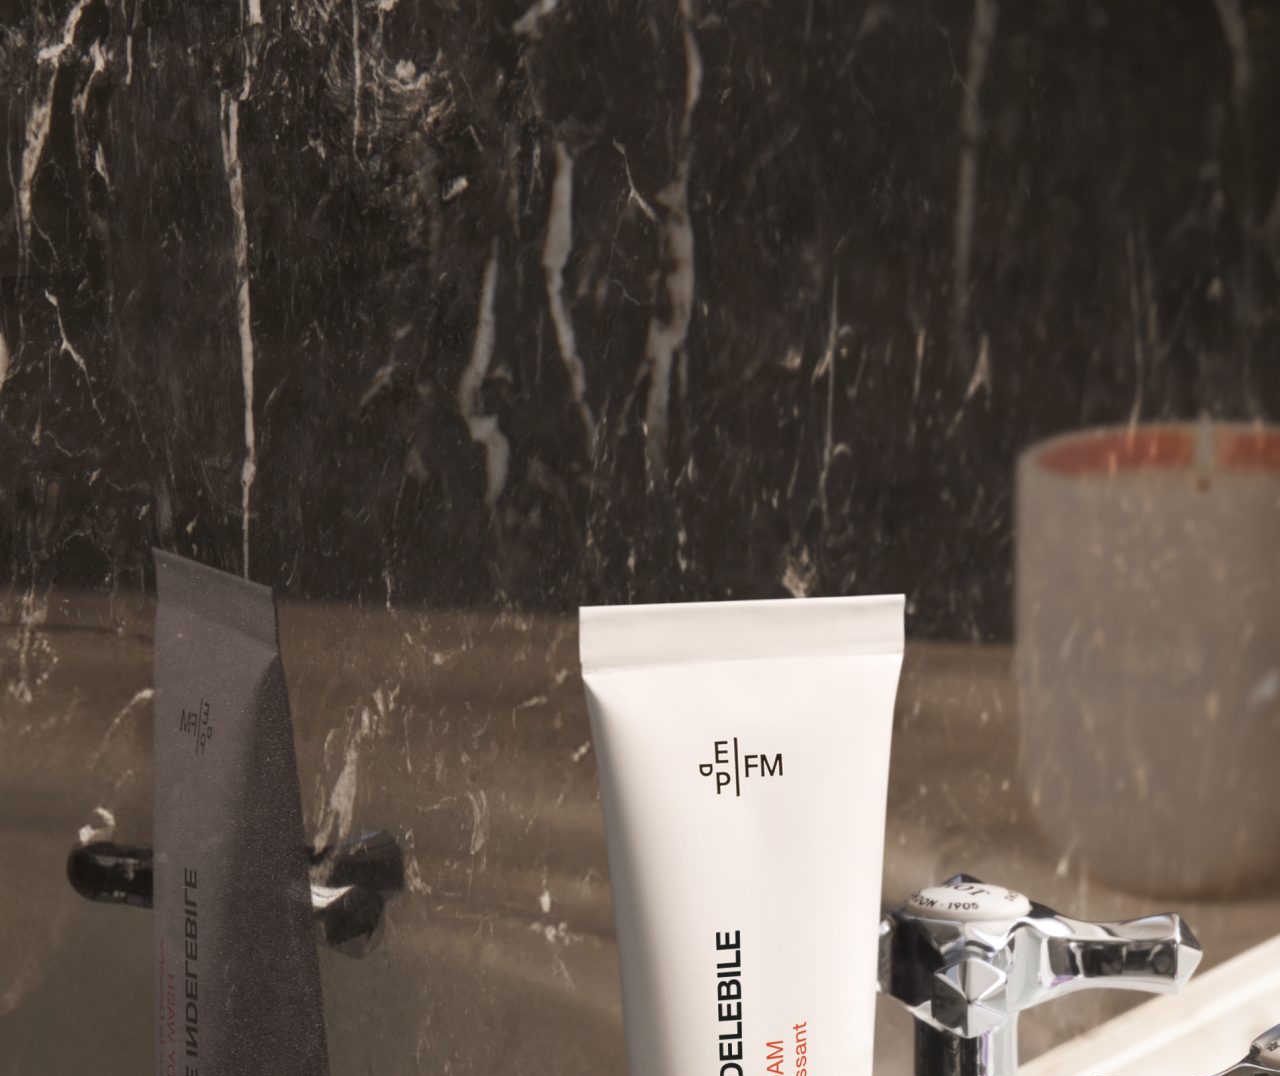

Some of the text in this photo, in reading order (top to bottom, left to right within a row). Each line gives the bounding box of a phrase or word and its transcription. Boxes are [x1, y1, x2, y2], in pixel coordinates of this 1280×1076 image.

[744, 753, 784, 778] FM
[943, 882, 991, 897] OT
[947, 901, 980, 910] 1905
